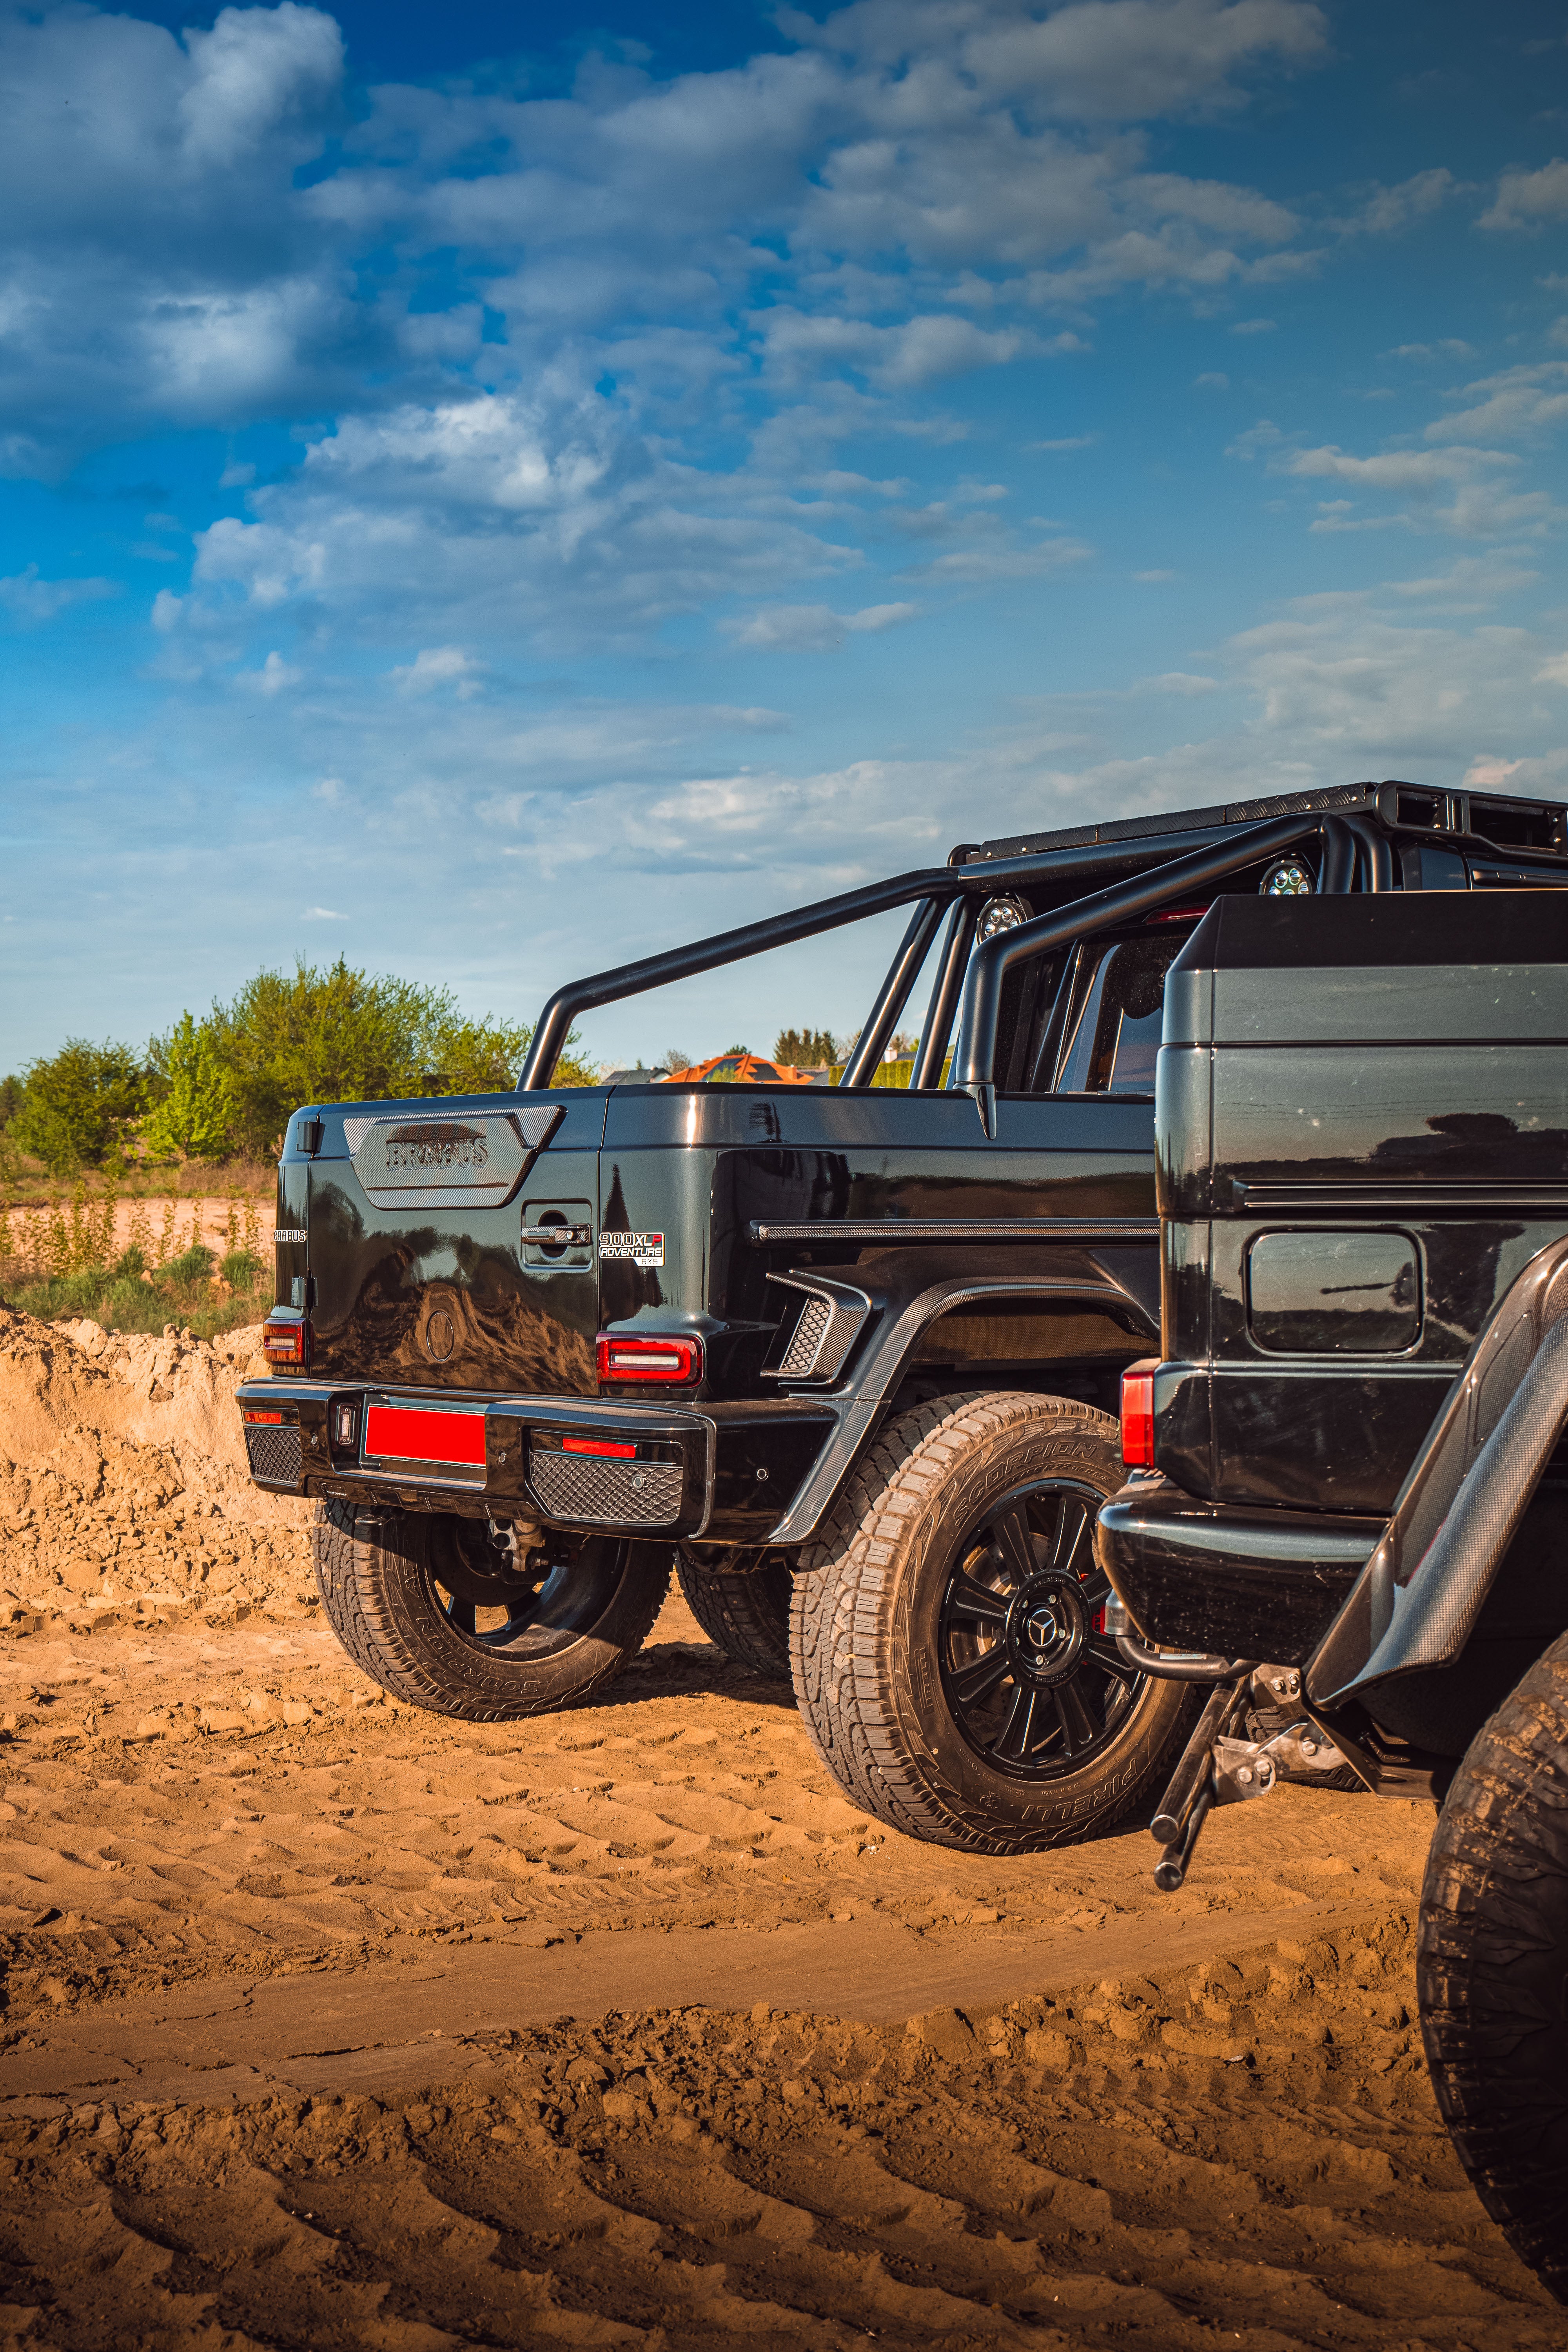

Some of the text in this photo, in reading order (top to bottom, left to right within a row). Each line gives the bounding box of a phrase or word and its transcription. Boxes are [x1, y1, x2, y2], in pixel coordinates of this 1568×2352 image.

[274, 1229, 307, 1242] BRABUS
[601, 1247, 662, 1257] ADVENTURE
[953, 1441, 1098, 1527] SCORPION
[416, 1617, 541, 1694] SCORPION
[1021, 1758, 1138, 1822] PIRELLI
